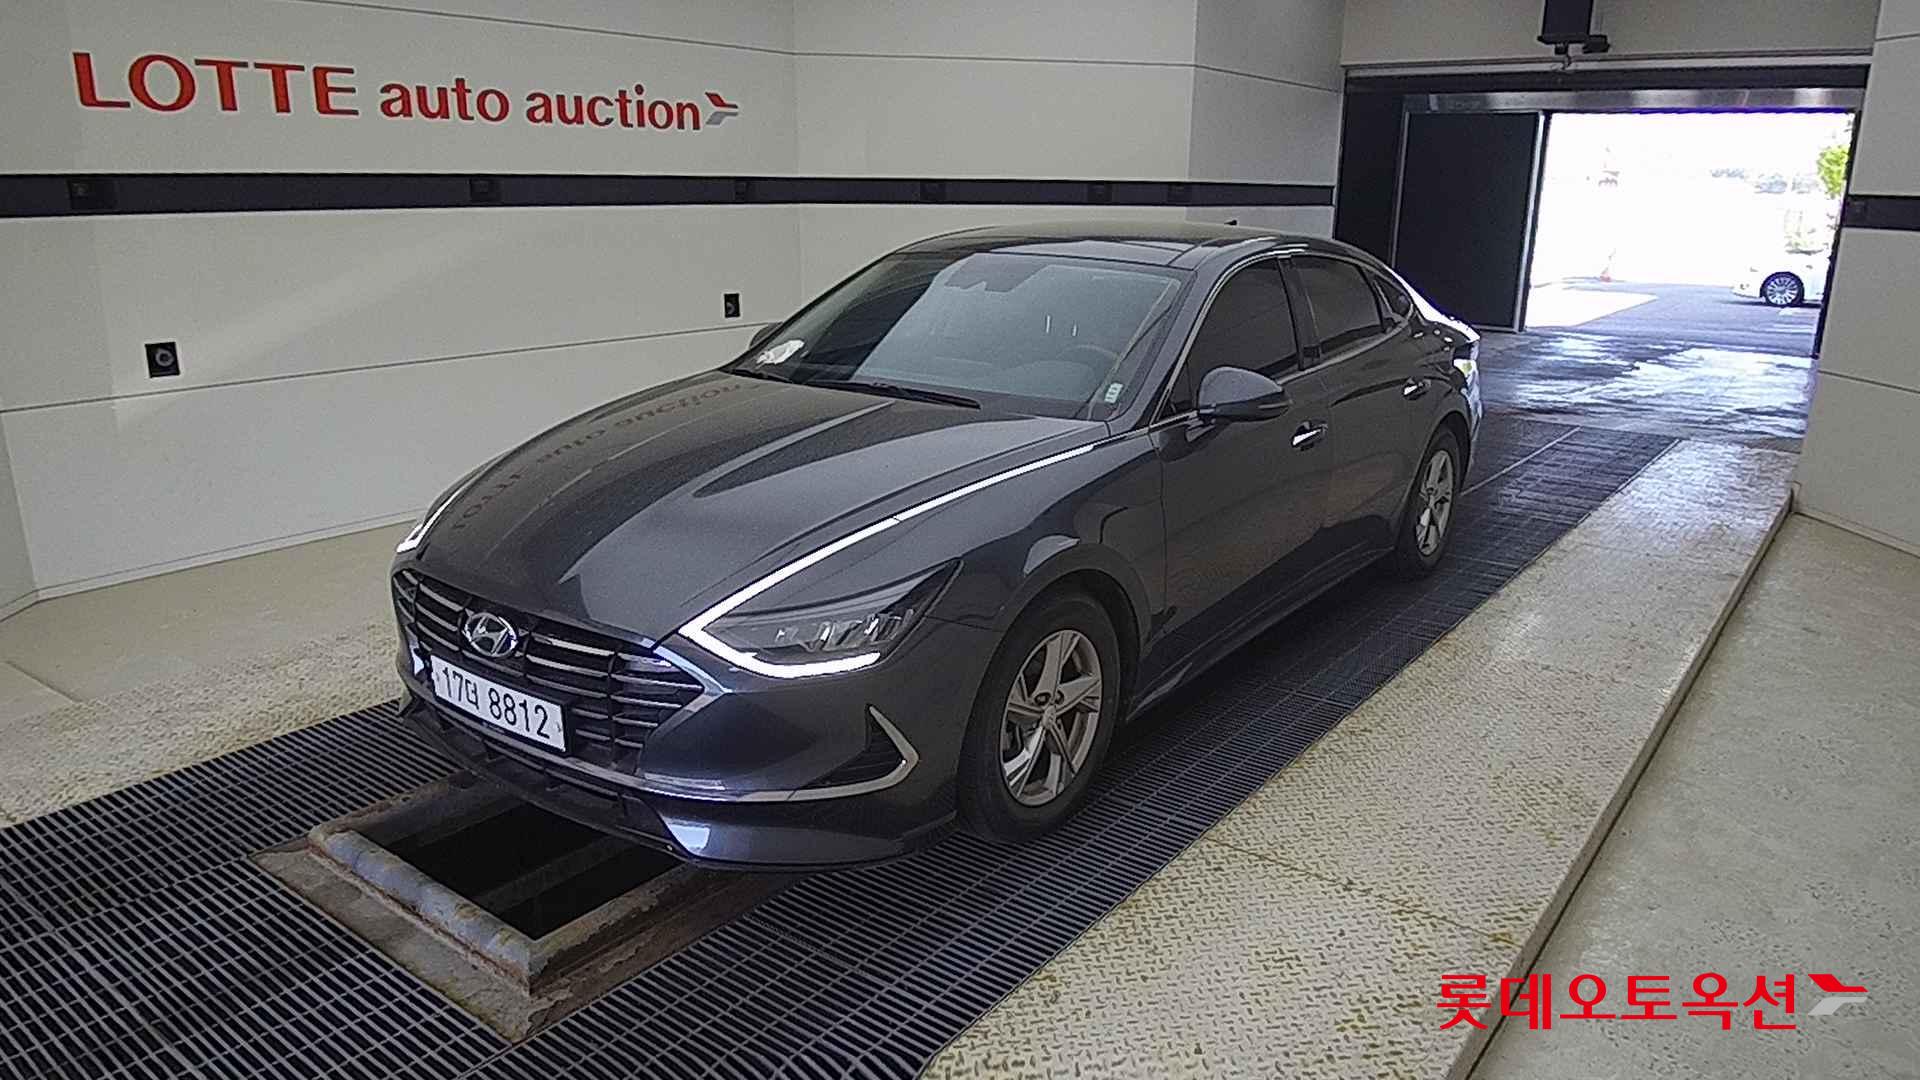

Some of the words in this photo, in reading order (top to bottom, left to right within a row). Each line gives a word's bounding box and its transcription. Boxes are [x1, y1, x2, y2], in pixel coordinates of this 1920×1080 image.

[72, 52, 360, 118] LOTTE
[379, 77, 510, 123] auto
[525, 84, 702, 131] auction
[442, 667, 480, 710] 17더
[488, 687, 551, 739] 8812
